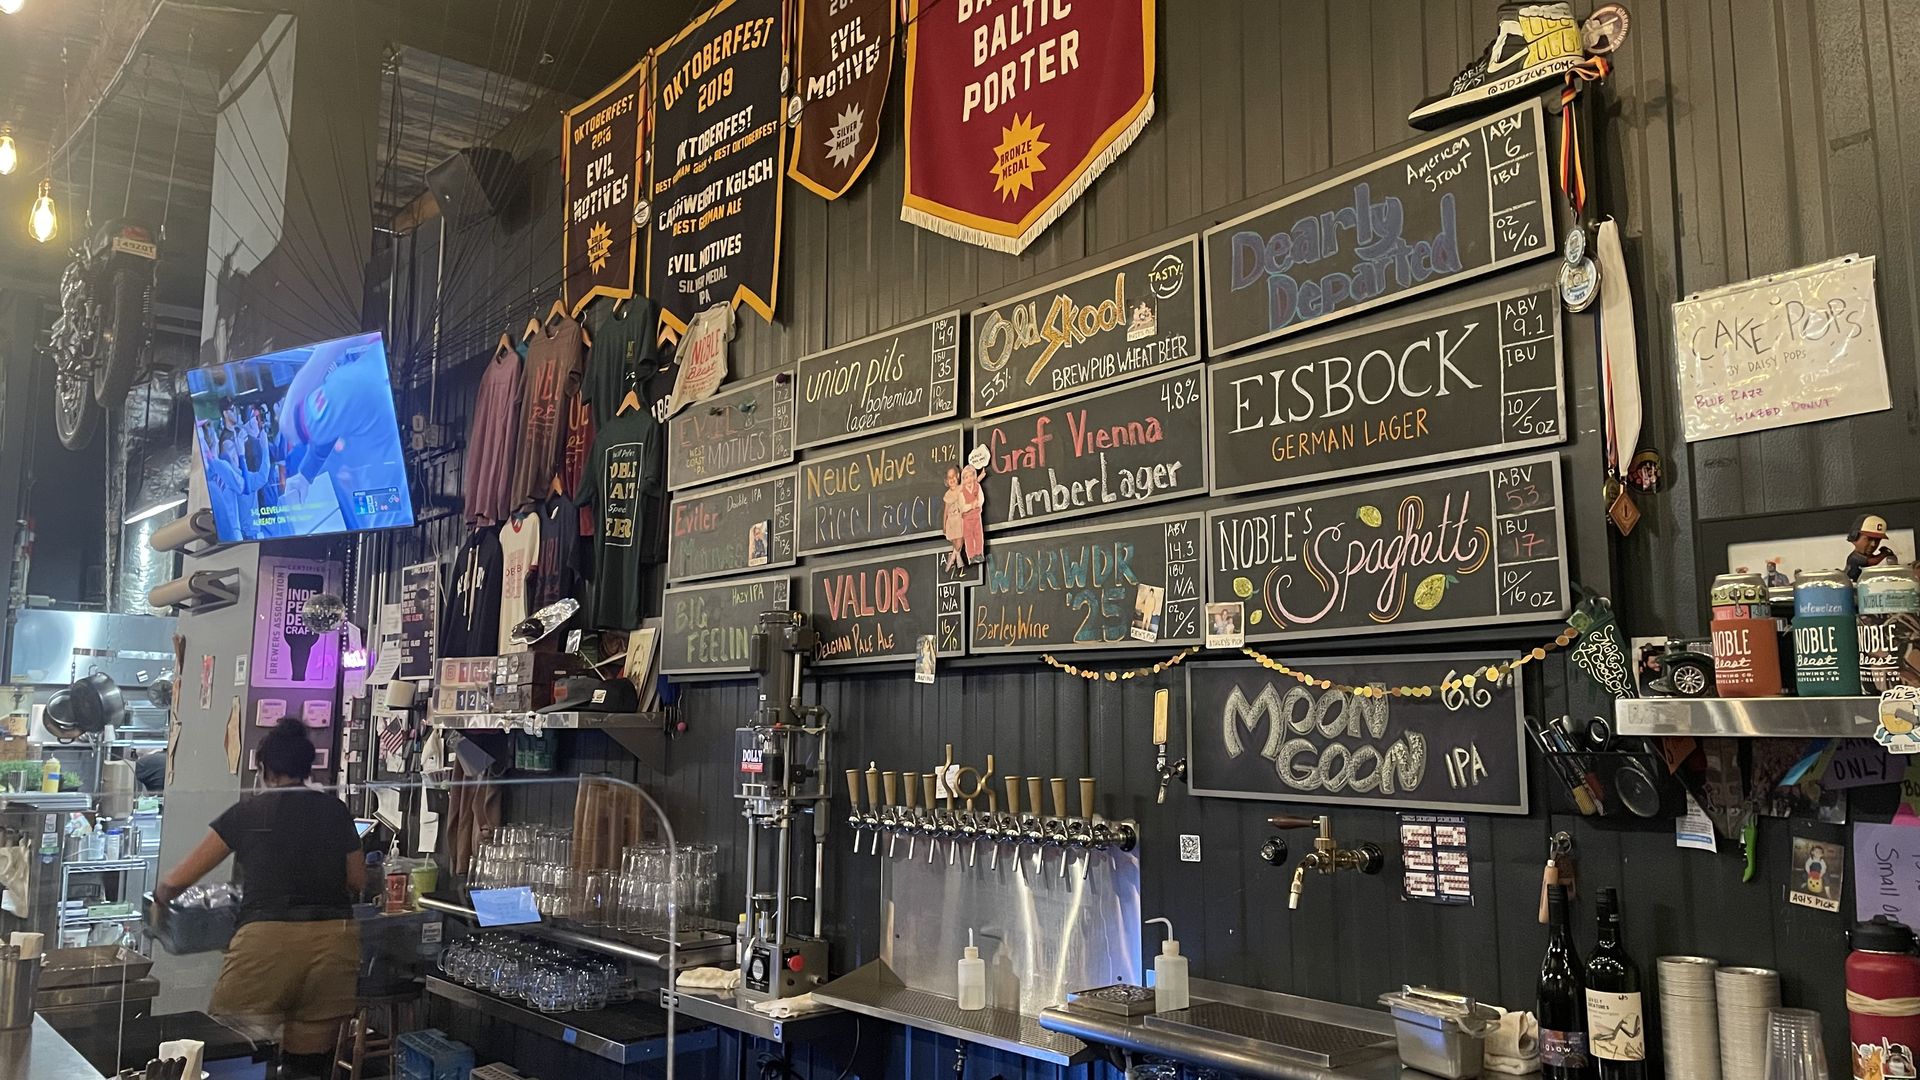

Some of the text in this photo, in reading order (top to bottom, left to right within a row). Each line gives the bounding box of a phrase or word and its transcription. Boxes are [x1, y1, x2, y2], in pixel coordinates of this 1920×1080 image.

[830, 16, 866, 62] EVIL
[974, 0, 1071, 67] BALTIC
[663, 17, 775, 111] OKTOBERFEST
[807, 35, 881, 102] MOTIVES
[962, 29, 1079, 122] PORTER
[698, 67, 734, 113] 2019
[574, 94, 634, 145] OKTOBERFEST
[836, 121, 858, 140] SILVER
[1489, 112, 1523, 140] ABV
[714, 143, 731, 161] BEST
[732, 120, 778, 153] OKTOBERFEST
[836, 134, 856, 150] MEDAL
[1000, 139, 1032, 166] BRONZE
[1505, 137, 1521, 157] 6
[587, 153, 614, 188] EVIL
[1002, 156, 1030, 181] MEDAL
[1407, 137, 1470, 185] American
[1424, 152, 1472, 192] STOUT
[1492, 163, 1521, 186] IBU
[573, 173, 628, 225] MOTIVES
[673, 197, 742, 237] BEST ALE
[1231, 182, 1404, 293] Dearly
[668, 253, 697, 277] EVIL
[1148, 264, 1185, 283] TASTY!
[1268, 192, 1463, 332] Departed
[699, 288, 711, 305] IPA
[1505, 296, 1539, 320] ABV
[1025, 273, 1126, 386] Skool
[1513, 314, 1546, 337] 9.1
[1692, 298, 1862, 361] CAKE POPS
[691, 329, 720, 366] NOBLE
[1506, 346, 1537, 367] IBU
[807, 337, 905, 408] union pils
[938, 359, 951, 378] 35
[1052, 335, 1188, 391] BREWPUB WHEAT BEER
[1727, 350, 1808, 377] BY DAISY POPS
[981, 368, 1012, 407] 5.3%
[1229, 323, 1483, 434] EISBOCK
[866, 385, 923, 413] bohemian
[1160, 378, 1200, 413] 4.8%
[1694, 394, 1725, 410] BLUE
[846, 404, 881, 433] lager
[1735, 407, 1780, 423] GLAZED
[990, 409, 1164, 474] Graf Vienna
[1272, 408, 1429, 462] GERMAN LAGER
[708, 432, 765, 469] MOTIVES
[807, 450, 916, 500] Neue Wave
[1497, 466, 1533, 490] ABV
[1168, 520, 1188, 537] ABV
[1218, 506, 1314, 572] NOBLE'S
[1500, 518, 1529, 537] IBU
[1877, 523, 1884, 532] C
[1169, 541, 1195, 560] 14.3
[1275, 491, 1480, 624] Spaghett
[1514, 534, 1545, 557] 17
[1169, 564, 1185, 577] IBU
[732, 583, 764, 606] HAZY IPA
[823, 567, 911, 621] VALOR
[939, 586, 956, 598] IBU
[1174, 576, 1196, 596] N/A
[286, 614, 305, 626] DE
[287, 601, 305, 613] PE
[675, 596, 708, 634] BIG
[942, 600, 958, 613] N/A
[1800, 602, 1842, 614] hefeweizen
[268, 572, 285, 675] BREWERS ASSOCIATION
[687, 624, 760, 663] FEELIN
[815, 623, 895, 662] BELGIAN PALE ALE
[1712, 629, 1751, 657] NOBLE
[1796, 626, 1837, 655] NOBLE
[1857, 624, 1899, 653] NOBLE
[1715, 657, 1751, 669] Beast
[1797, 655, 1837, 667] Beast
[1859, 654, 1899, 666] Beast
[1223, 682, 1390, 761] MOON
[742, 748, 763, 763] DOLLY
[1275, 729, 1427, 795] GOON
[1445, 740, 1488, 790] IPA
[1834, 752, 1887, 780] ONLY
[1875, 842, 1900, 896] Small
[1815, 898, 1836, 909] PICK
